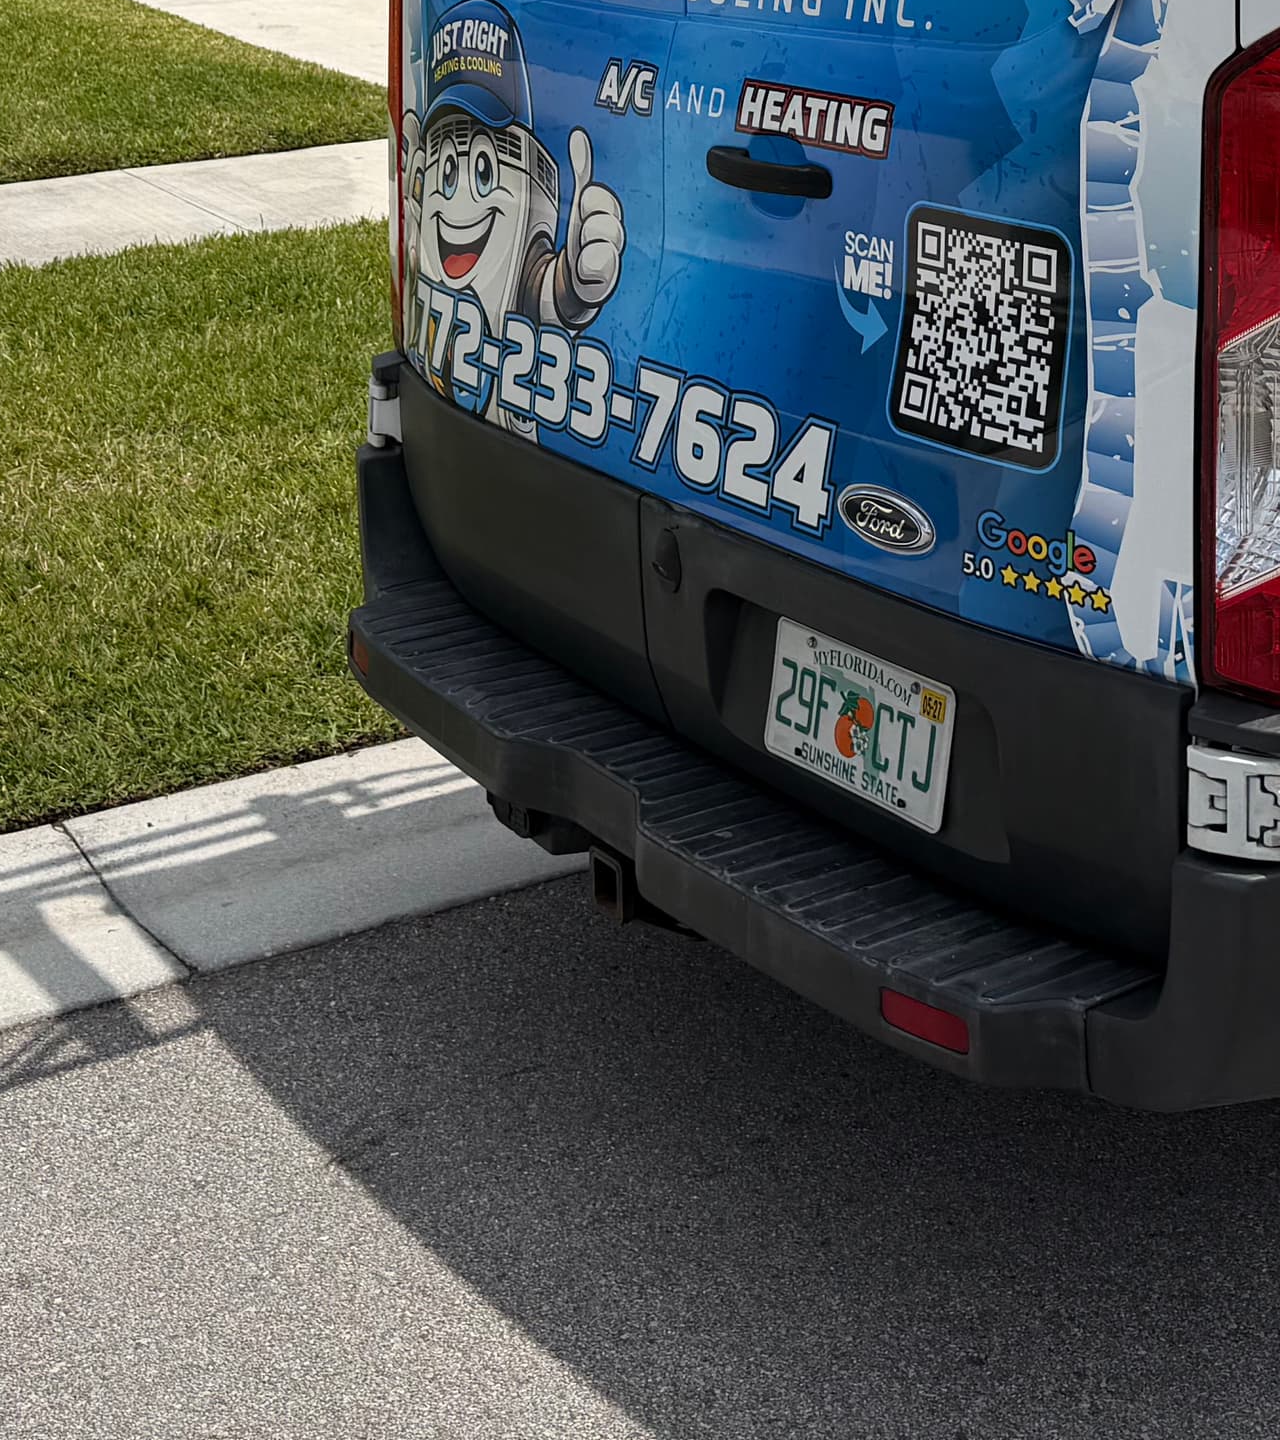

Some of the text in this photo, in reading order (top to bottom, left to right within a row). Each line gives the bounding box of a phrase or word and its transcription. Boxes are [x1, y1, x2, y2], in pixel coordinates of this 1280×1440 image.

[431, 19, 508, 69] JUST RIGHT
[434, 56, 503, 84] HEATING & COOLING
[597, 61, 892, 155] A/C AND HEATING
[845, 230, 894, 263] SCAN
[843, 254, 893, 300] ME!
[416, 278, 834, 532] 772-233-7624
[855, 499, 905, 540] Ford
[977, 510, 1096, 575] Google
[962, 552, 994, 580] 5.0
[813, 649, 912, 707] MYFLORIDA.COM
[775, 657, 937, 793] 29F CTJ
[922, 694, 943, 722] 05-27
[801, 742, 897, 805] SUNSHINE STATE
